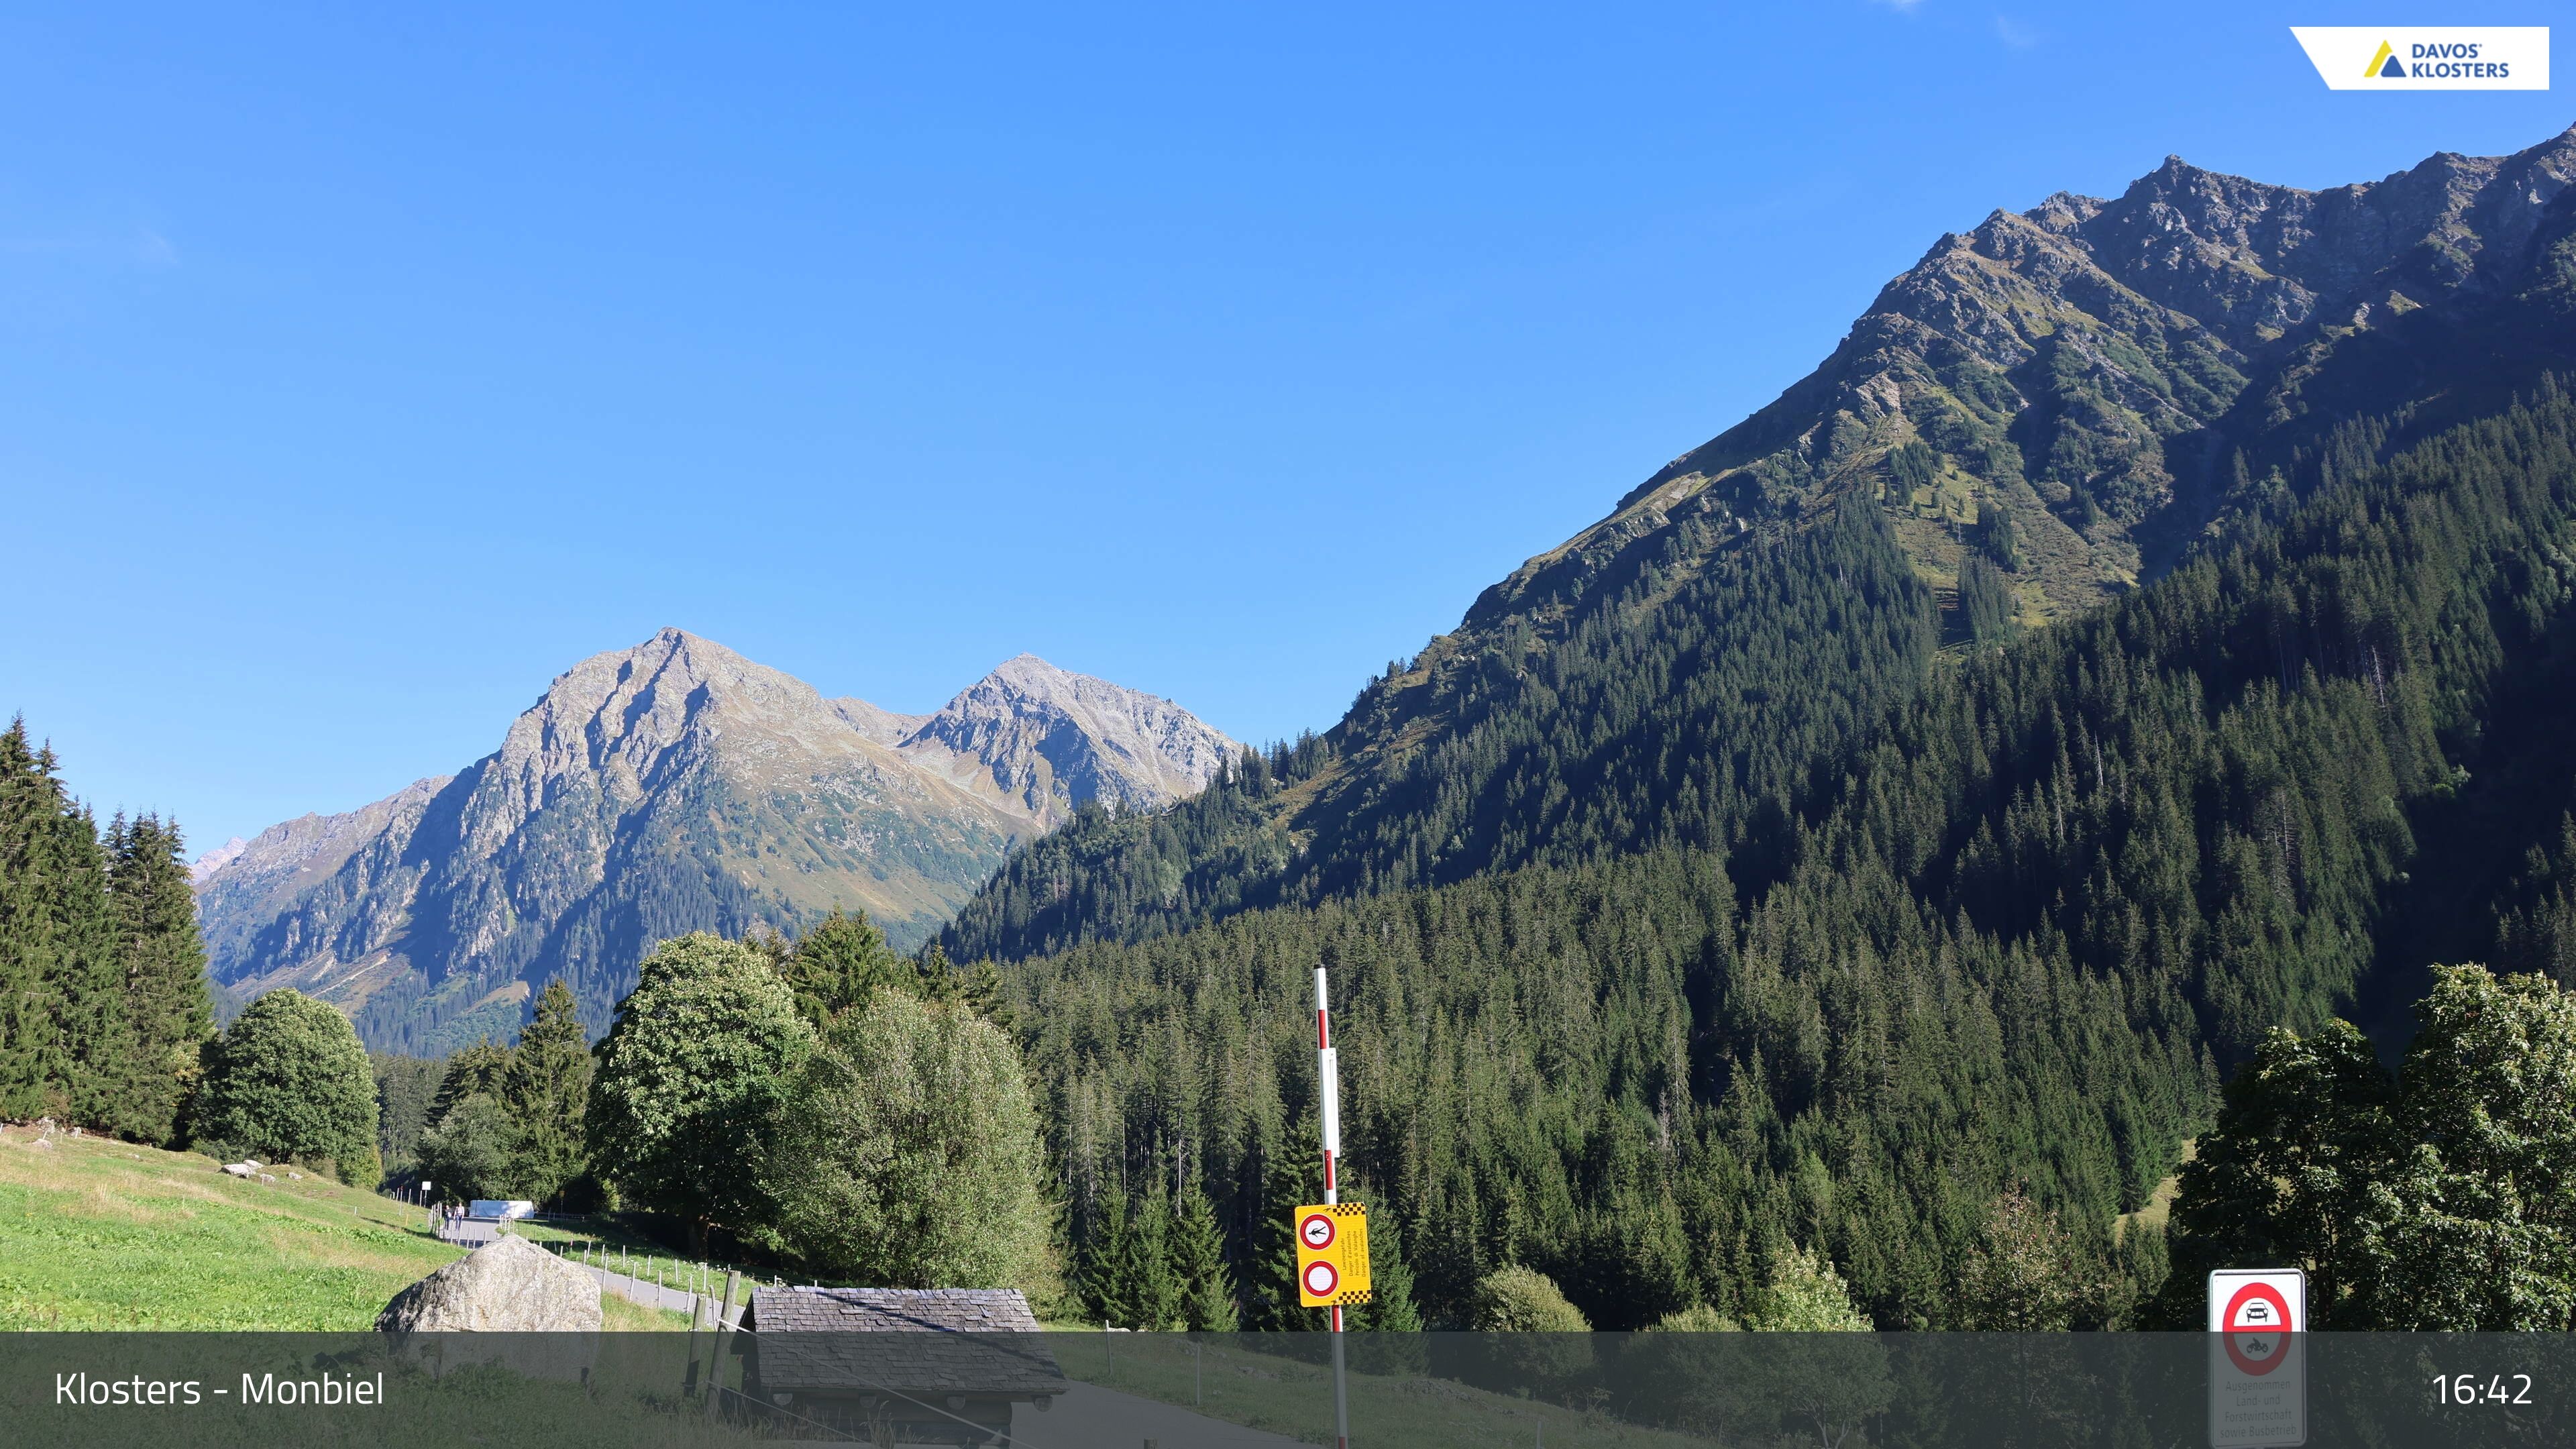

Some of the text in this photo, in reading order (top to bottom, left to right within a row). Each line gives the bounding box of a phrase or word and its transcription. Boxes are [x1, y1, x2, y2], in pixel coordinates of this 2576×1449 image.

[2226, 1381, 2291, 1394] Ausgenommen
[2237, 1393, 2281, 1406] Land- und
[2225, 1408, 2292, 1422] Forstwirtschaft
[2220, 1423, 2296, 1438] sowie Busbetrieb
